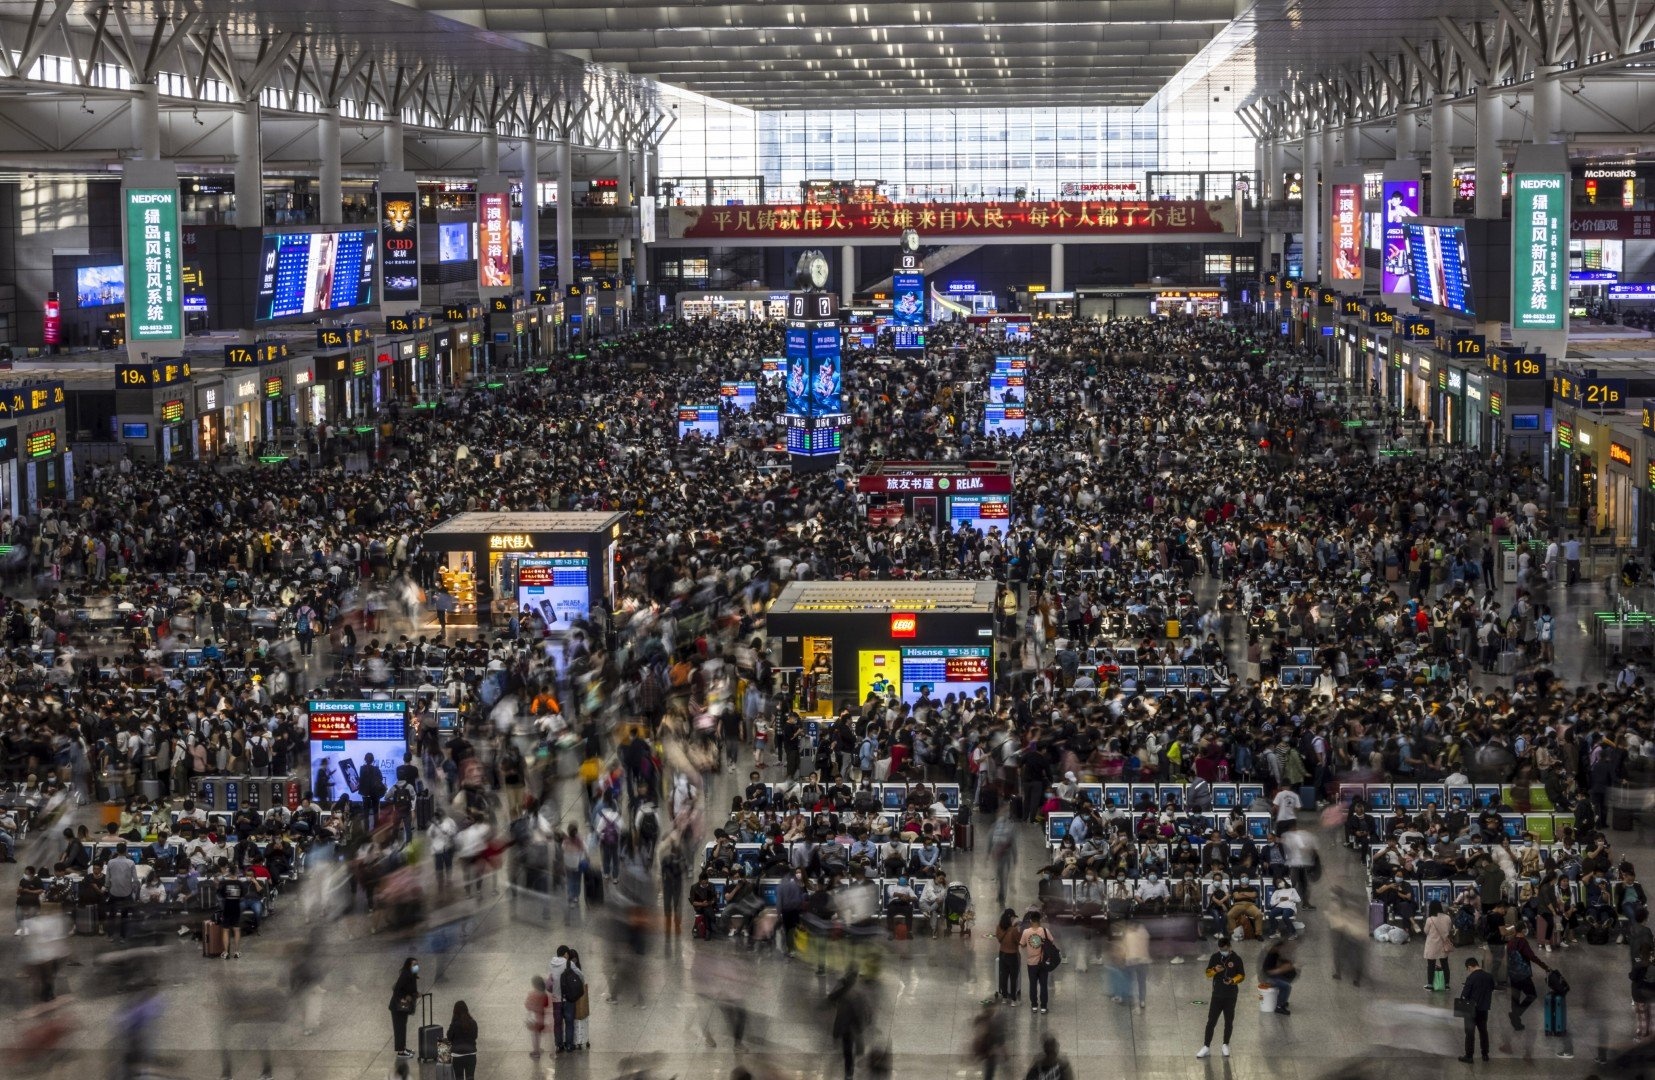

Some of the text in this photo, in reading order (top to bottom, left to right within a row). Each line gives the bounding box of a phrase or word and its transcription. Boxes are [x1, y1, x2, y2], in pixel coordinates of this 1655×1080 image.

[1584, 169, 1637, 178] McDonald's
[1520, 179, 1560, 189] NEDFON
[131, 194, 172, 204] NEDFON
[386, 239, 414, 250] CBD
[393, 250, 407, 258] 家居
[1530, 194, 1548, 310] 绿岛风新风系统
[144, 208, 164, 321] 绿岛风新风系统
[571, 286, 580, 295] 5A
[602, 281, 611, 289] 3A
[535, 293, 546, 302] 7A
[495, 300, 507, 310] 9A
[447, 309, 463, 319] 11A
[1374, 312, 1393, 323] 13B
[390, 320, 409, 330] 13A
[1409, 324, 1430, 336] 15B
[321, 332, 342, 344] 15A
[1456, 340, 1480, 353] 17B
[229, 349, 252, 362] 17A
[1513, 359, 1540, 374] 19B
[121, 370, 146, 384] 19A
[1587, 385, 1619, 402] 21B
[886, 477, 934, 490] 旅友书屋
[490, 535, 534, 549] 绝代佳人
[892, 620, 915, 631] LEGO
[907, 648, 944, 656] Hisense
[315, 702, 355, 710] Hisense
